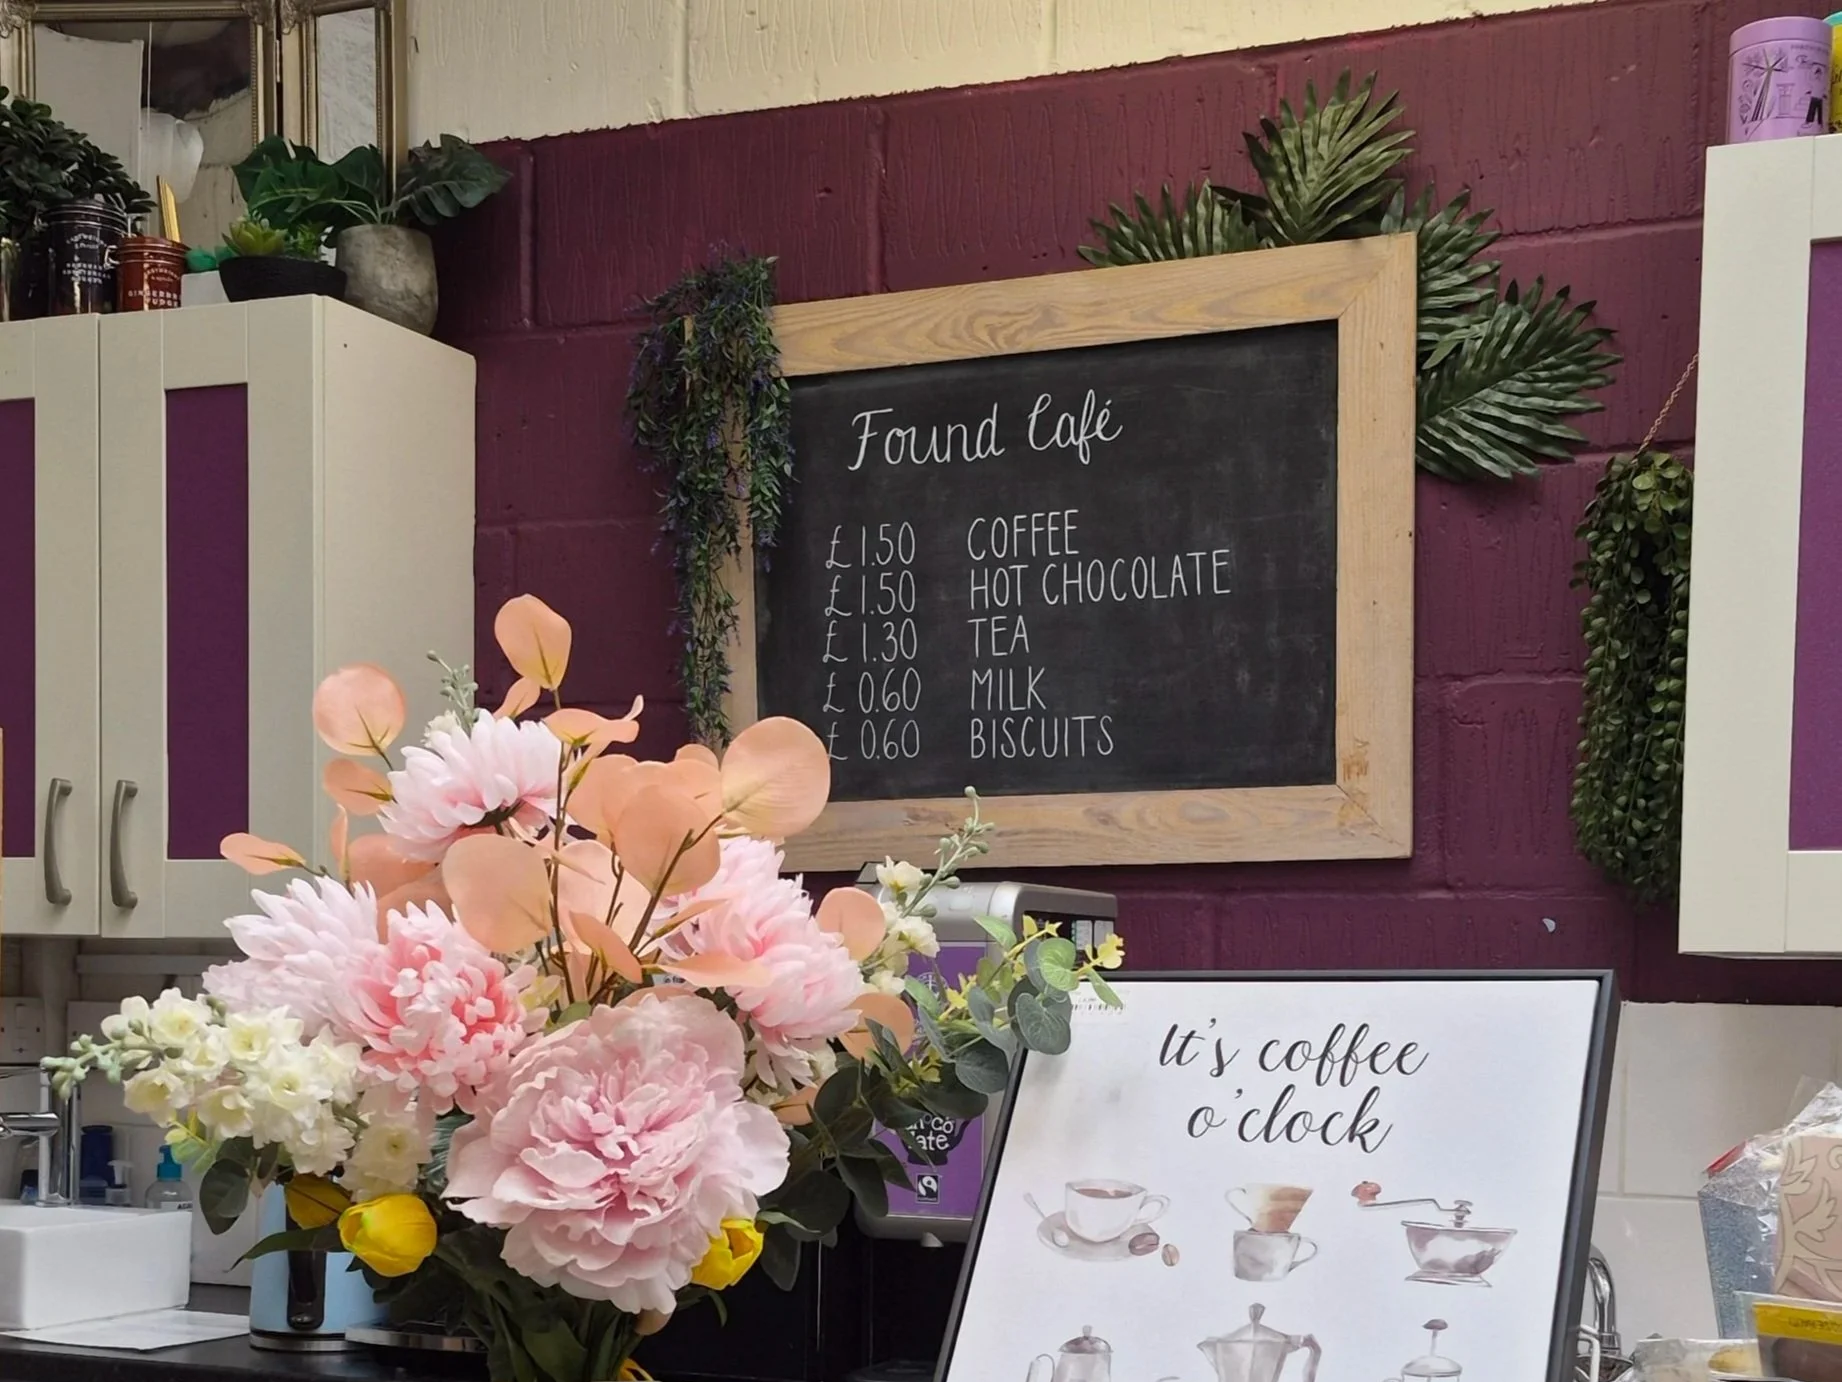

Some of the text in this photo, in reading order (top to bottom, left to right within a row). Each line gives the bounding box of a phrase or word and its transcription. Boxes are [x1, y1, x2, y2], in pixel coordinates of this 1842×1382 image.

[848, 389, 1123, 471] Found Café
[967, 509, 1080, 561] COFFEE
[970, 564, 1029, 610] HOT
[1041, 549, 1232, 606] CHOCOLATE
[967, 614, 1030, 658] TEA
[970, 665, 1047, 711] MILK
[970, 714, 1114, 760] BISCUITS
[1258, 1022, 1430, 1087] coffee
